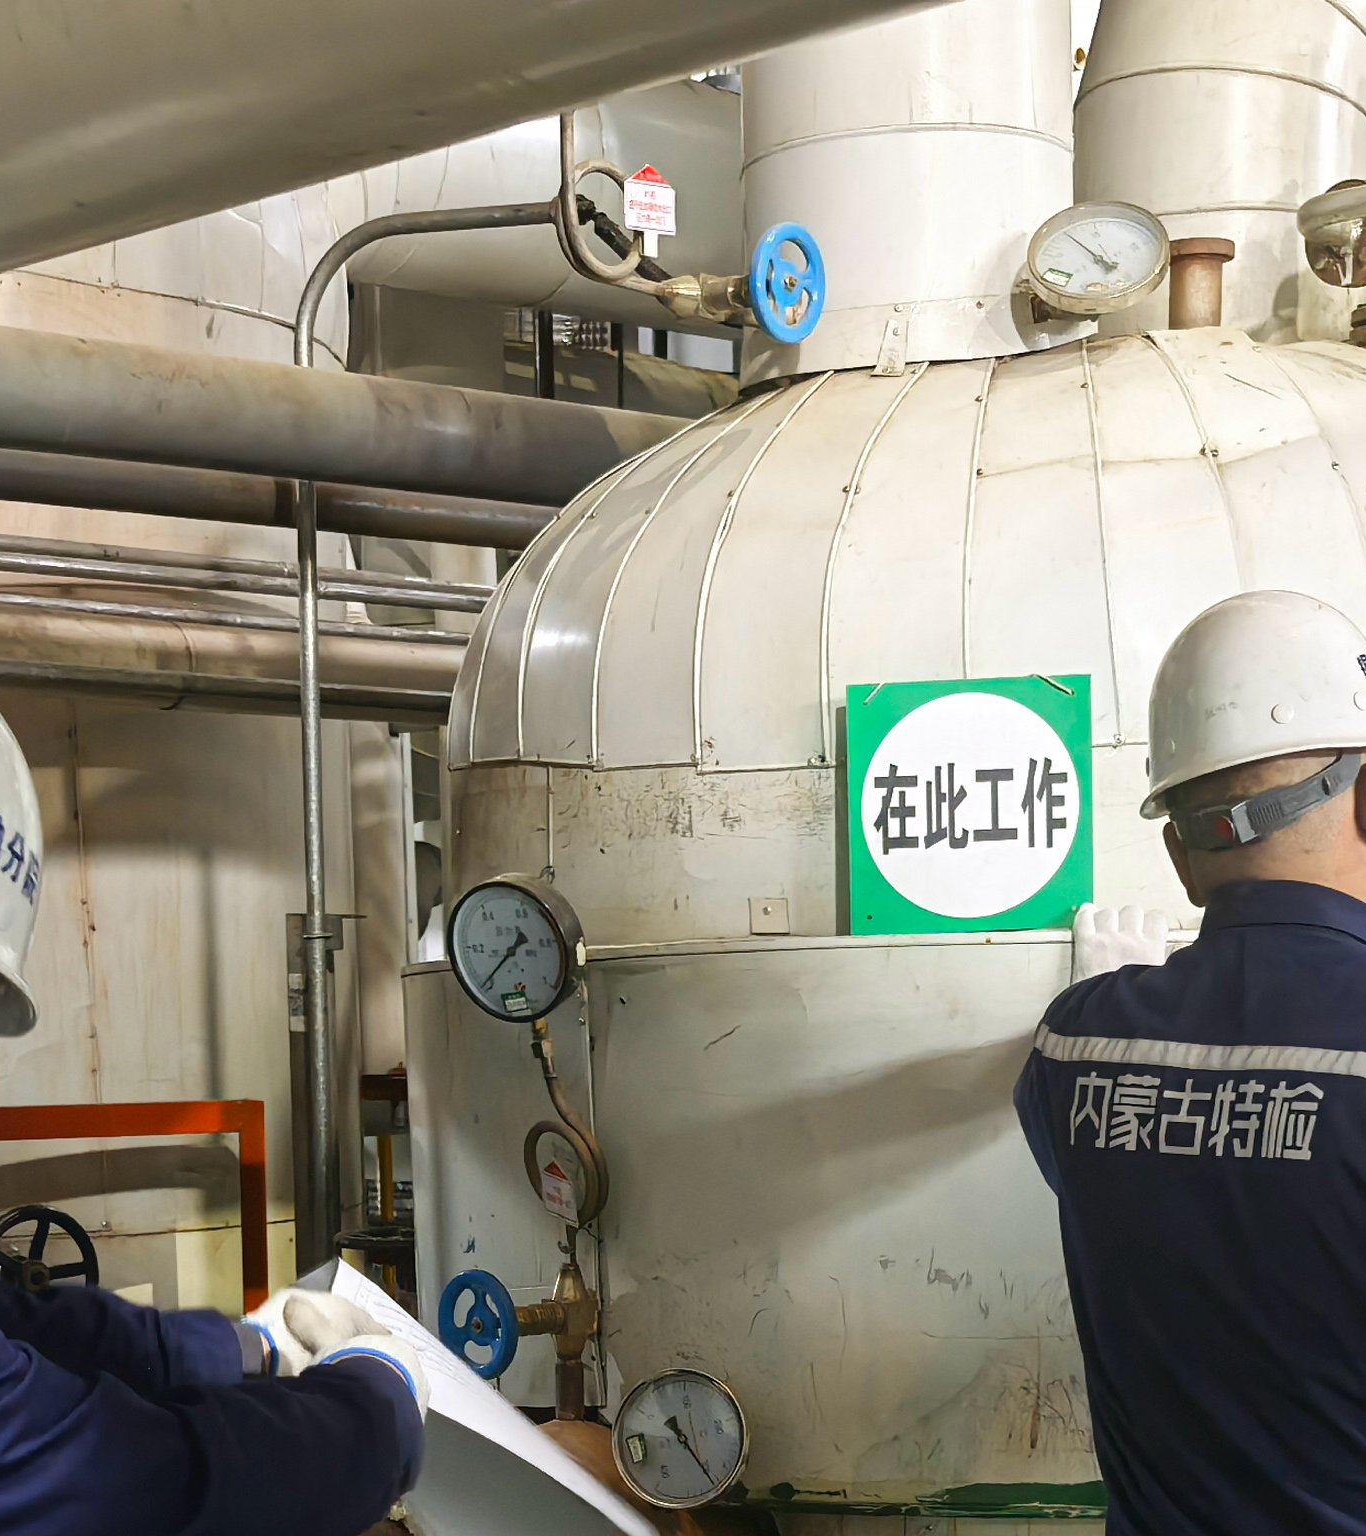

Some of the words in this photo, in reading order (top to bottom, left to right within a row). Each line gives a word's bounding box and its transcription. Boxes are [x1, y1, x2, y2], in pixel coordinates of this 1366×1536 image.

[873, 757, 1068, 855] 在此工作
[1069, 1071, 1325, 1161] 内蒙古特检
